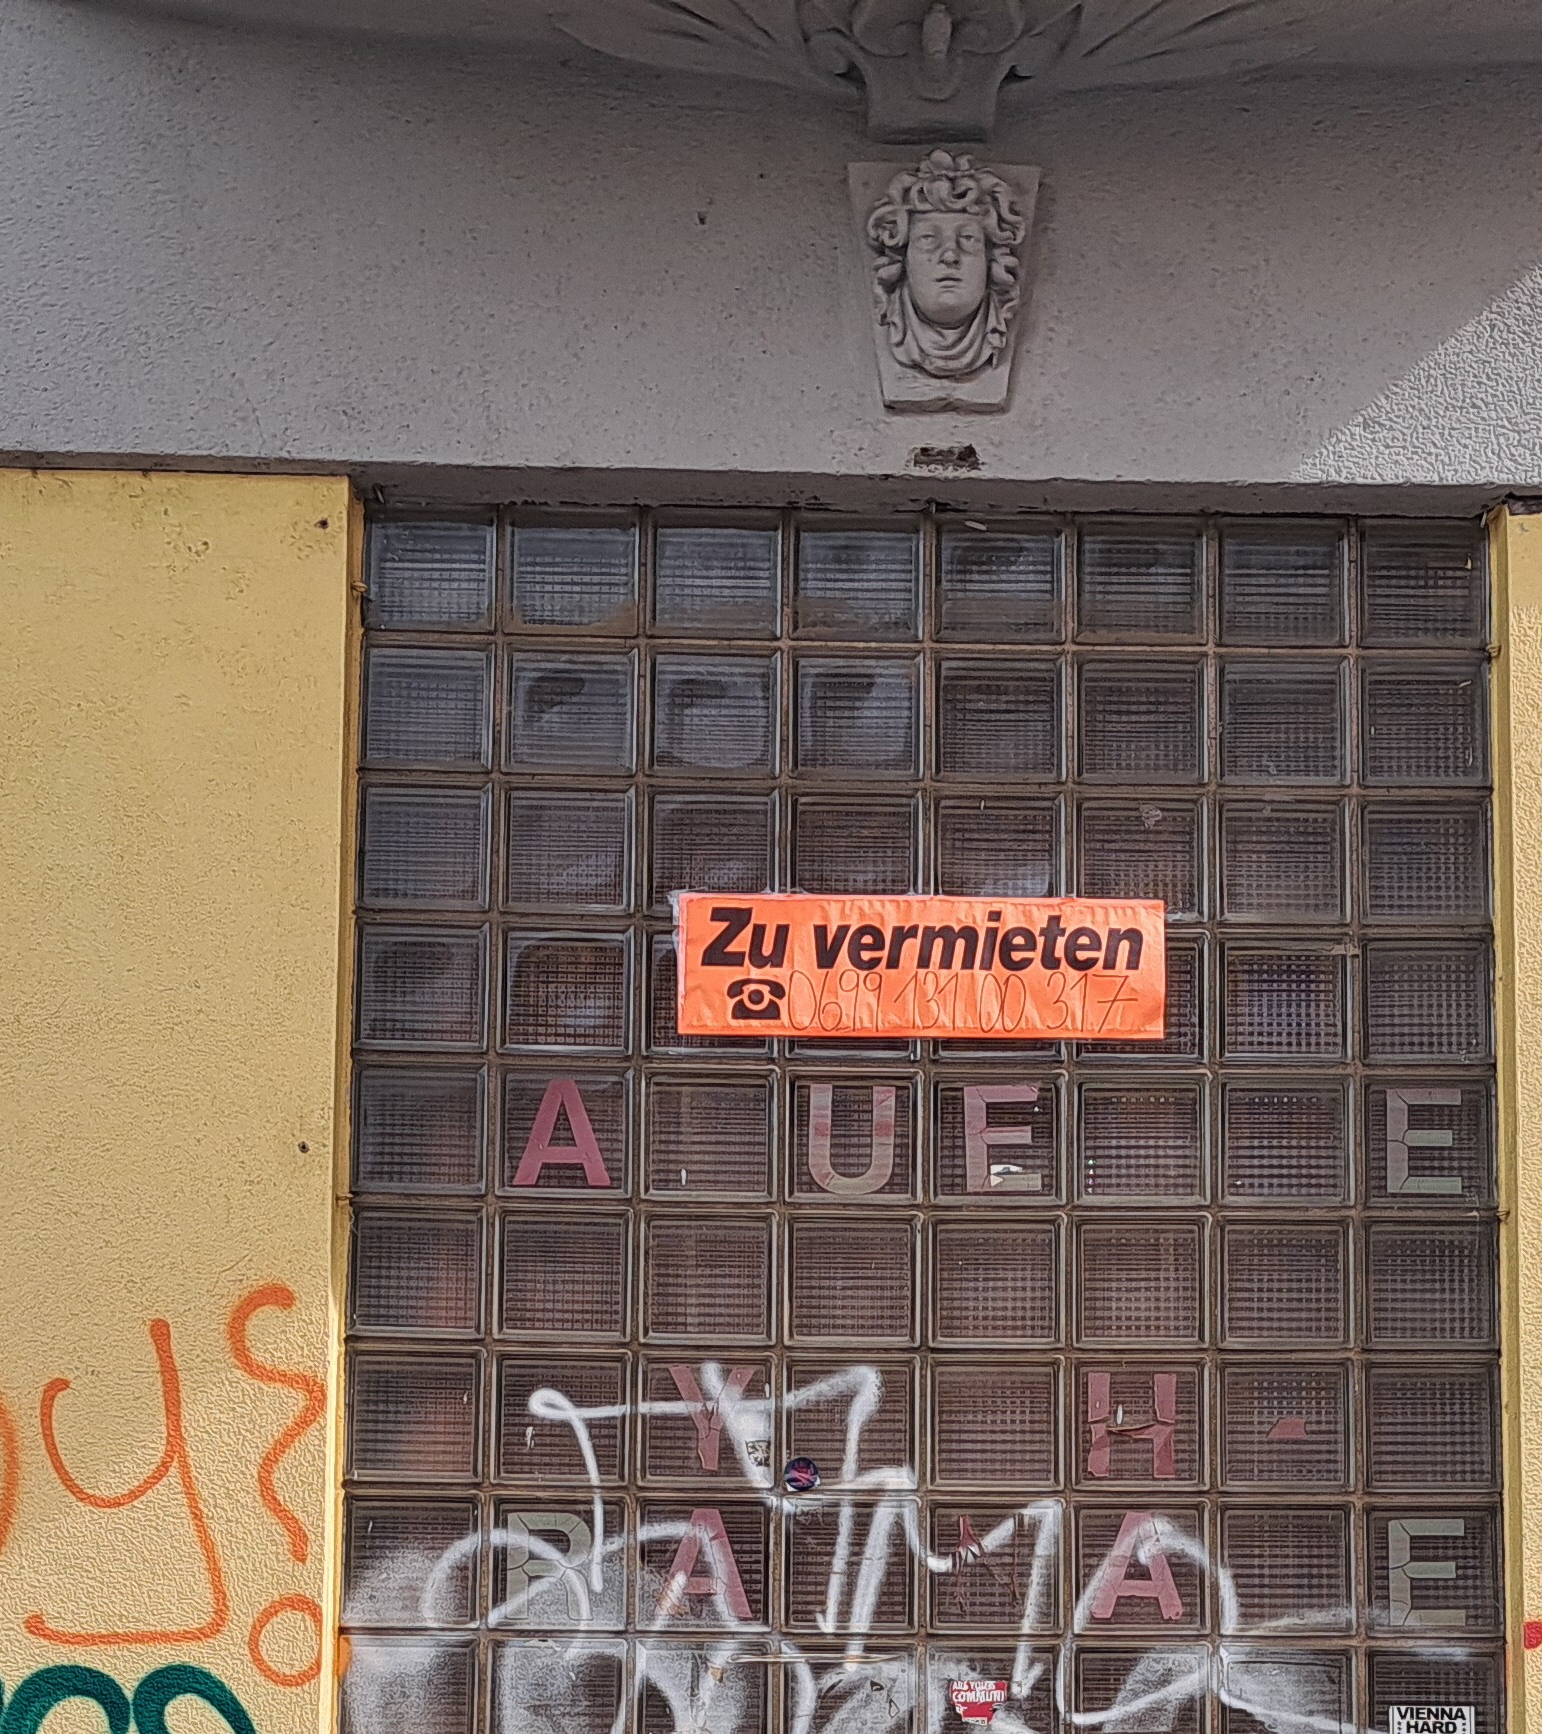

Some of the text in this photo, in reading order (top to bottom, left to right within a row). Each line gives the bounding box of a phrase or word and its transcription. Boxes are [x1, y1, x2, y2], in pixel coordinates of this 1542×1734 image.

[700, 906, 1144, 972] Zu vermieten
[1397, 1706, 1467, 1721] VIENNA
[1406, 1721, 1458, 1734] HARD
